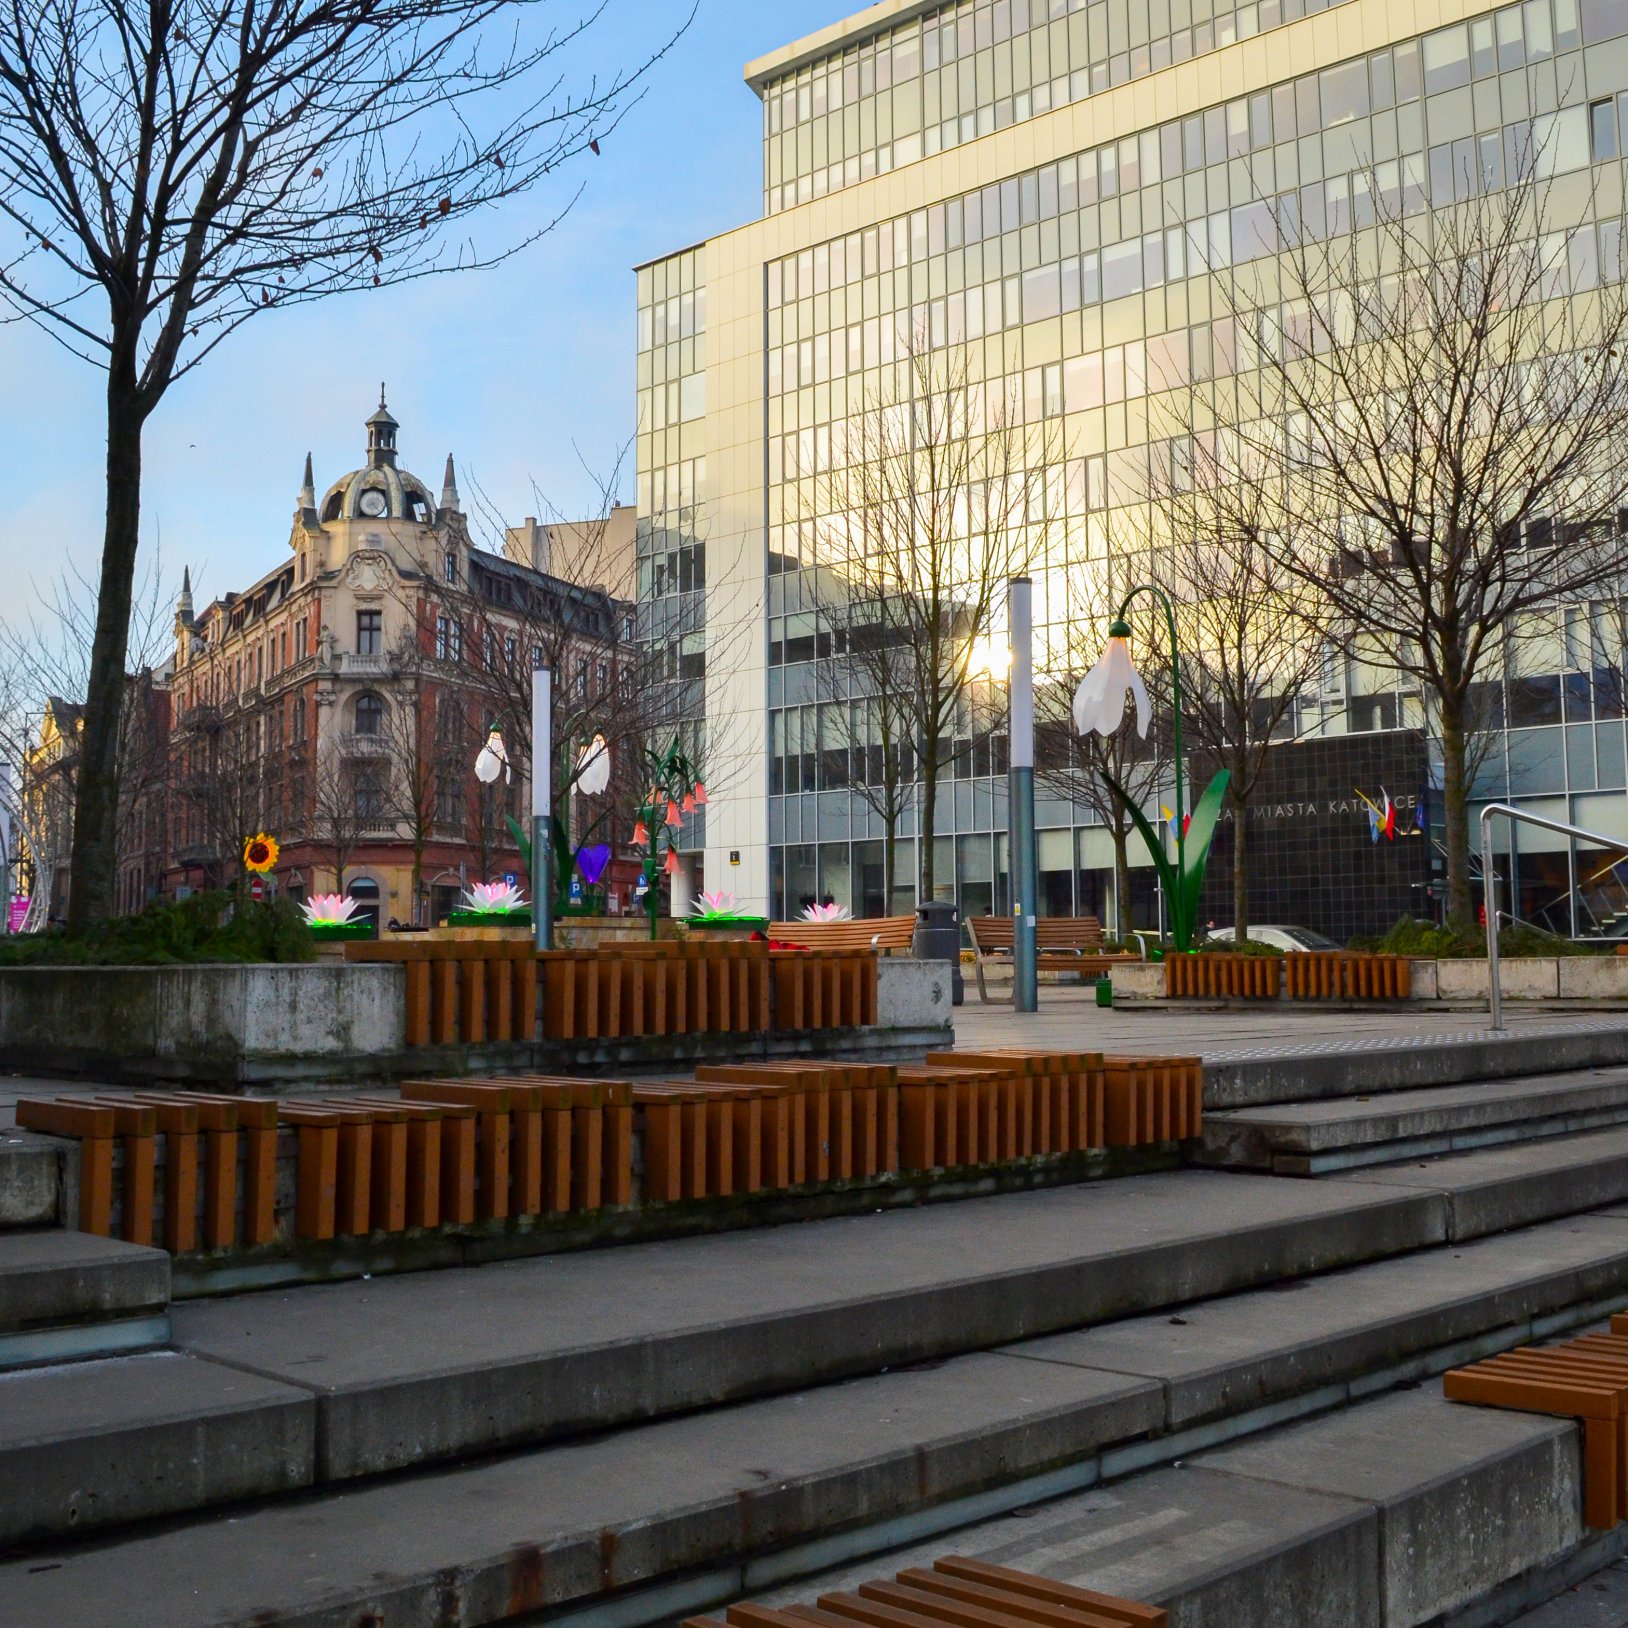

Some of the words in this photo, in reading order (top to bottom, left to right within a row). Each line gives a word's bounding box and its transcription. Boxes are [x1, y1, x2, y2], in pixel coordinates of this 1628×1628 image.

[1253, 803, 1317, 818] MIASTA
[1328, 795, 1416, 814] KATOWCE
[572, 883, 580, 893] P
